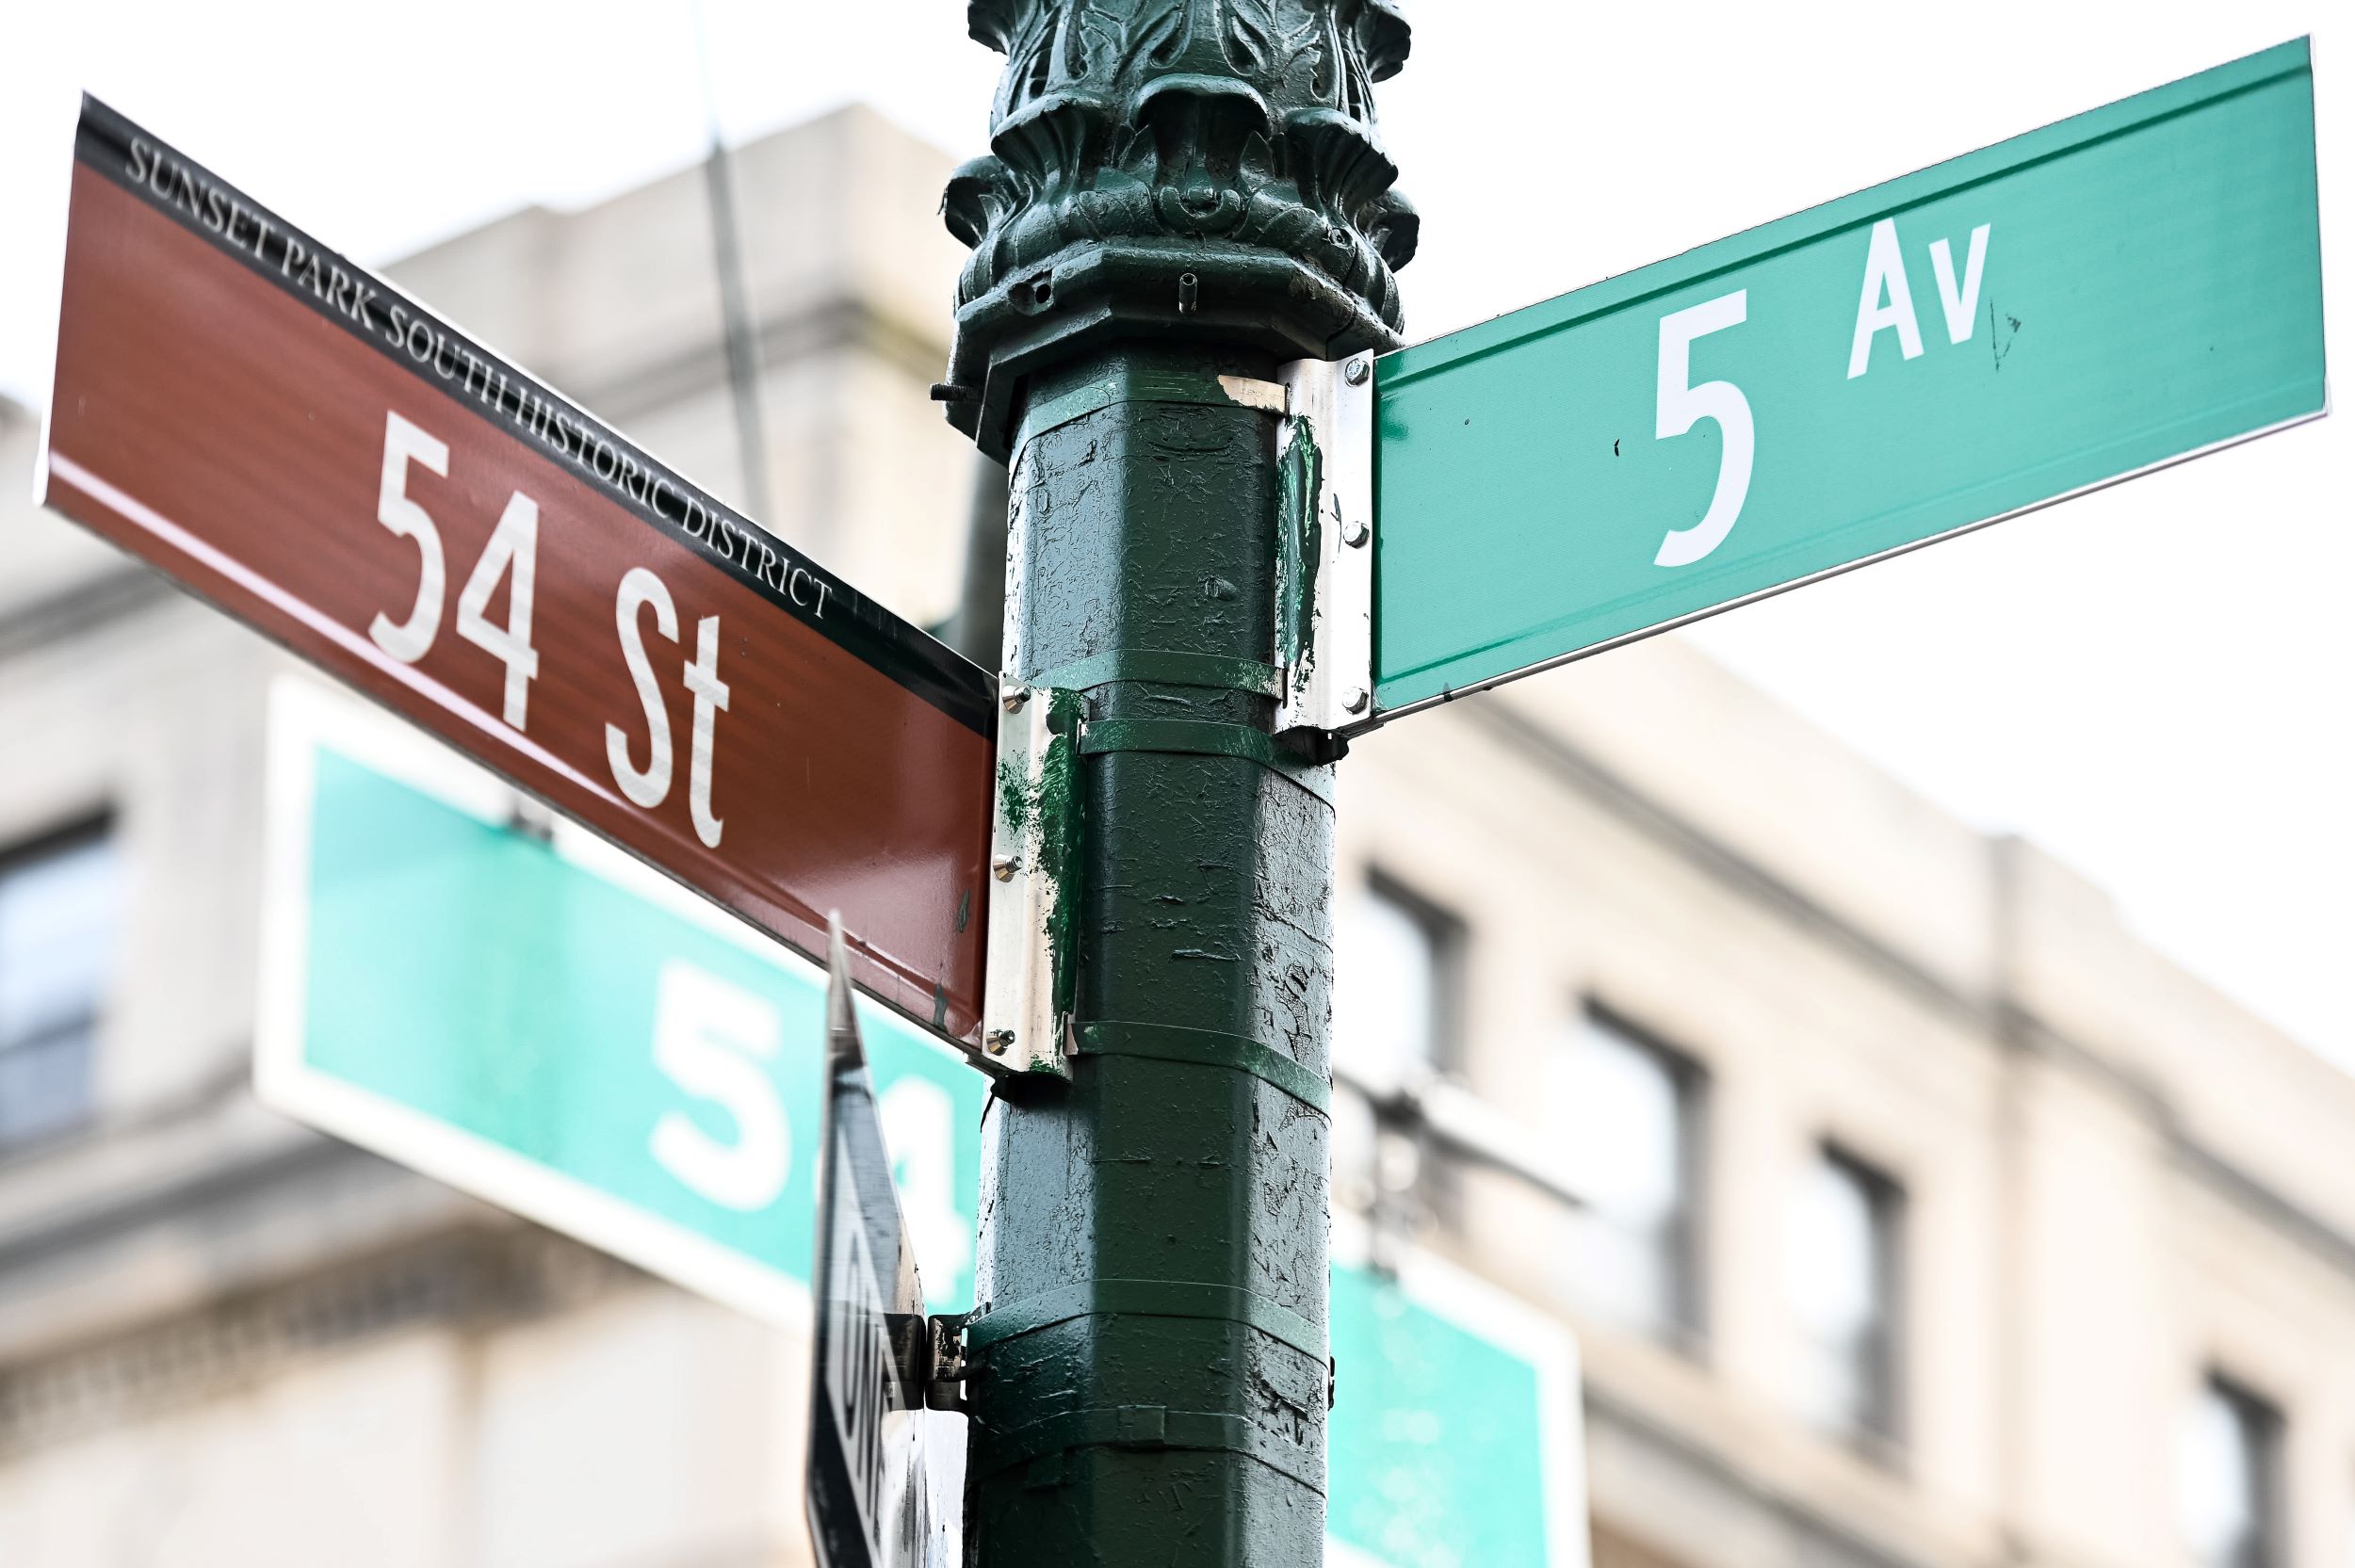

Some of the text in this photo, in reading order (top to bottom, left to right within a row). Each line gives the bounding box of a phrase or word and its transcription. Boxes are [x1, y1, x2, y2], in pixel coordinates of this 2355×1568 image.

[124, 136, 834, 621] SUNSET PARK SOUTH HISTORIC DISTRICT
[1653, 217, 1991, 566] 5 Av
[368, 409, 731, 849] 54 St
